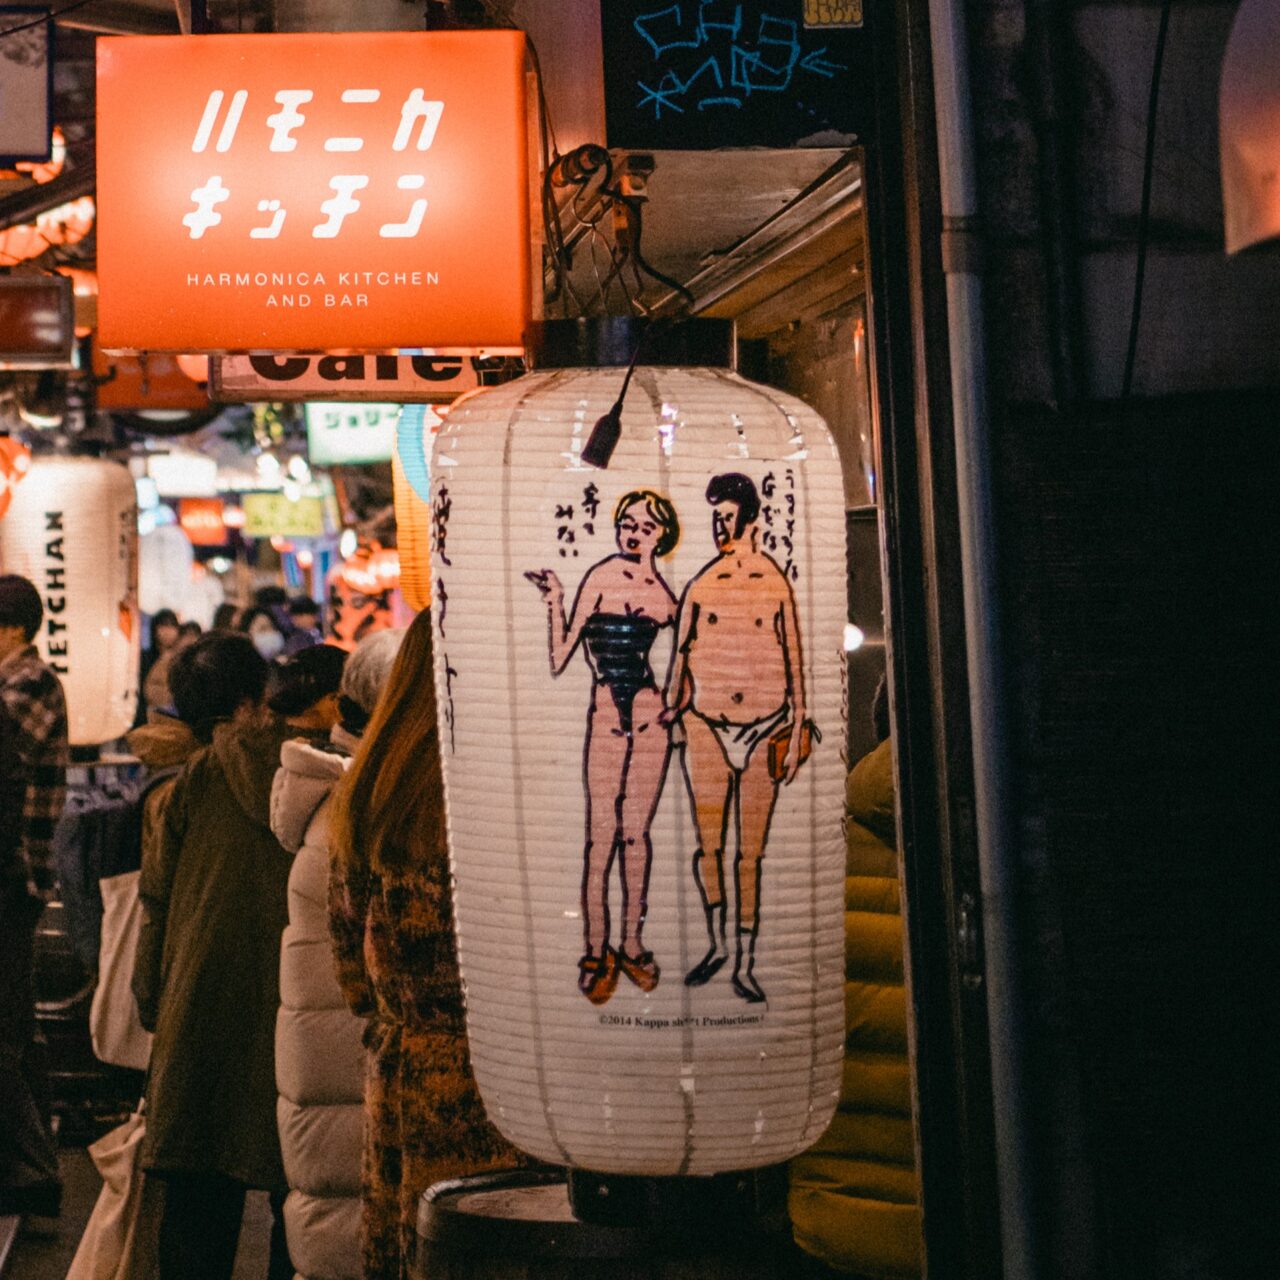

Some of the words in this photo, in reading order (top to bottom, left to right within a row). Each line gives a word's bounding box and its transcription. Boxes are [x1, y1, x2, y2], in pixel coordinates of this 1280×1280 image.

[191, 88, 445, 152] ハモニカ
[181, 175, 429, 239] キッチン
[186, 272, 327, 286] HARMONICA
[338, 271, 440, 285] KITCHEN
[266, 293, 312, 307] AND
[324, 293, 369, 307] BAR
[635, 1016, 670, 1030] Kappa
